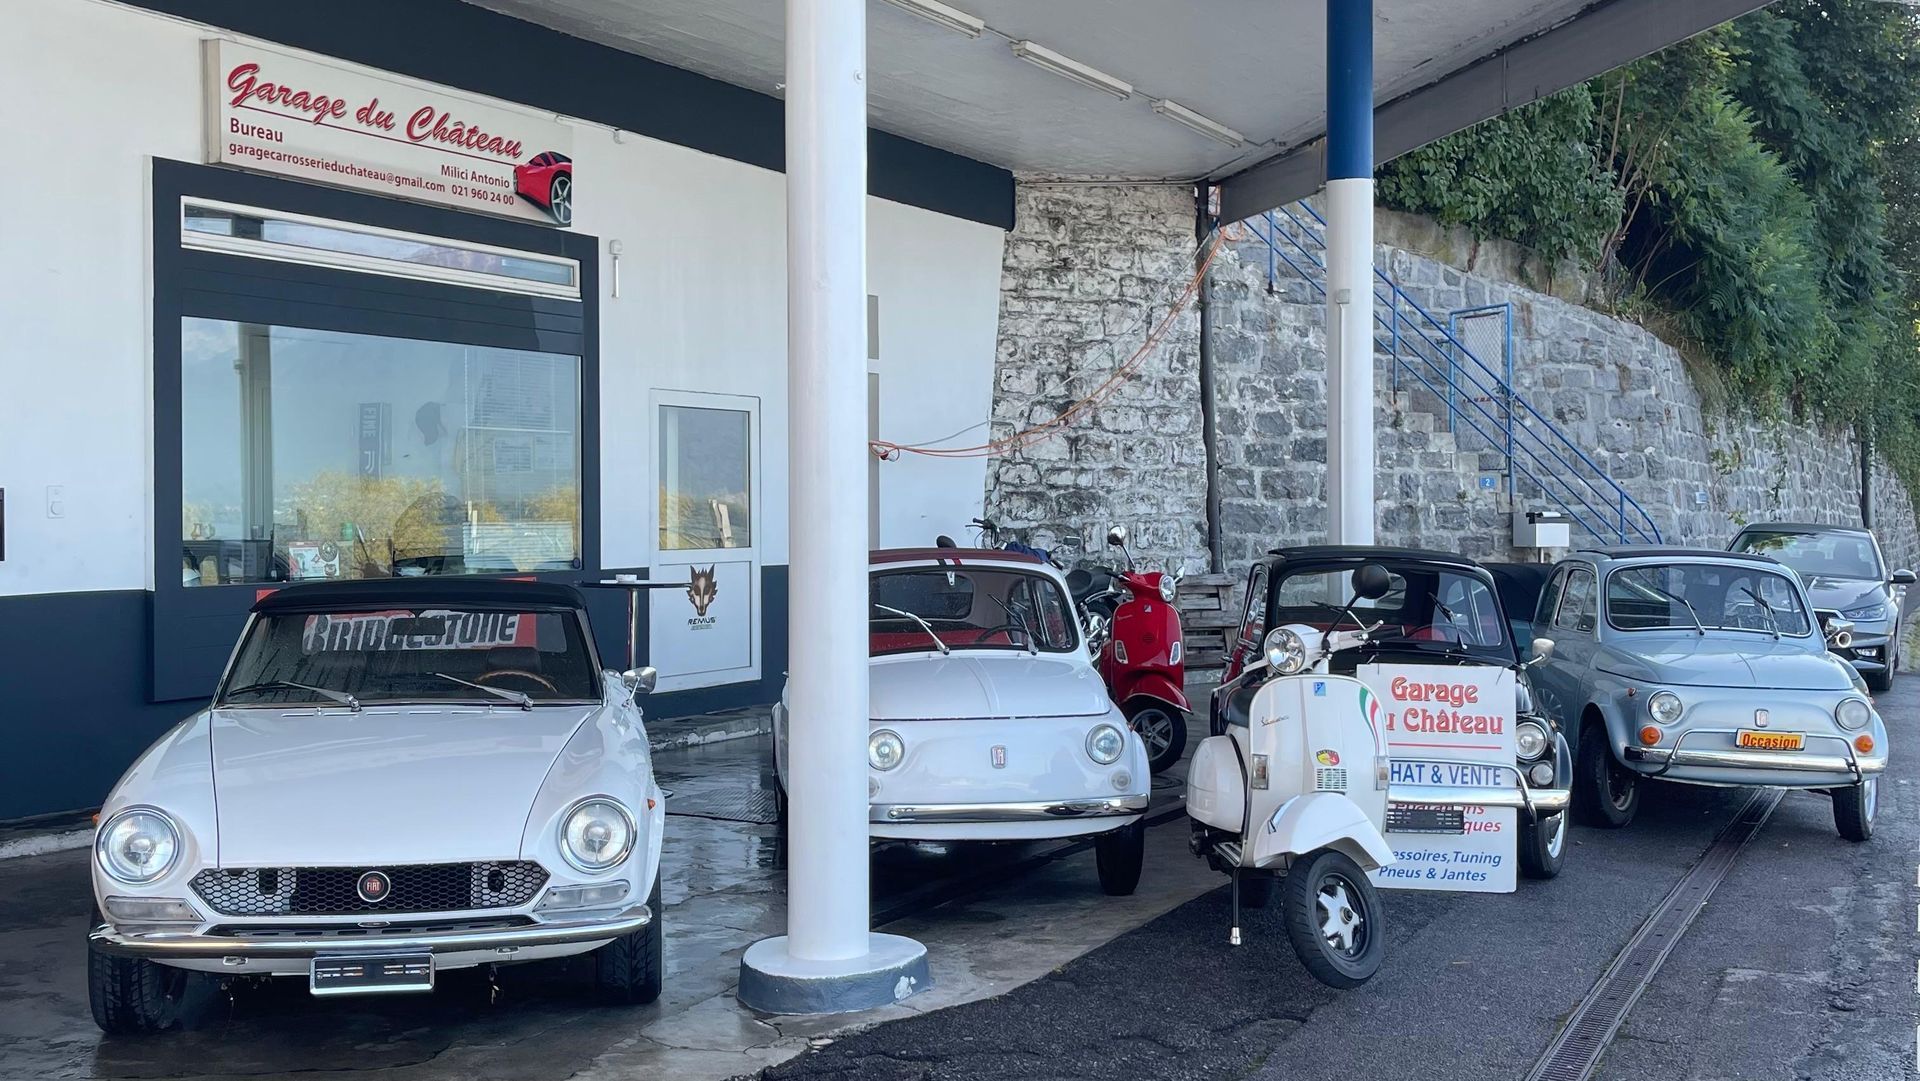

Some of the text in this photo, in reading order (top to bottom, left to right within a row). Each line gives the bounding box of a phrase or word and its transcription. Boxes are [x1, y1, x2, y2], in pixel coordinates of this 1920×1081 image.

[227, 63, 523, 159] Garage du Château
[230, 117, 283, 143] Bureau
[229, 143, 515, 206] garagecarrosserieduchateau@gmail.com 021 960 24 00
[440, 164, 511, 189] Milici Antonio
[687, 616, 716, 626] REMUS
[1391, 676, 1479, 708] Garage
[1403, 707, 1503, 735] Château
[1742, 733, 1798, 749] Occasion
[1390, 763, 1502, 786] HAT & VENTE
[1378, 866, 1487, 882] Pneus & Jantes
